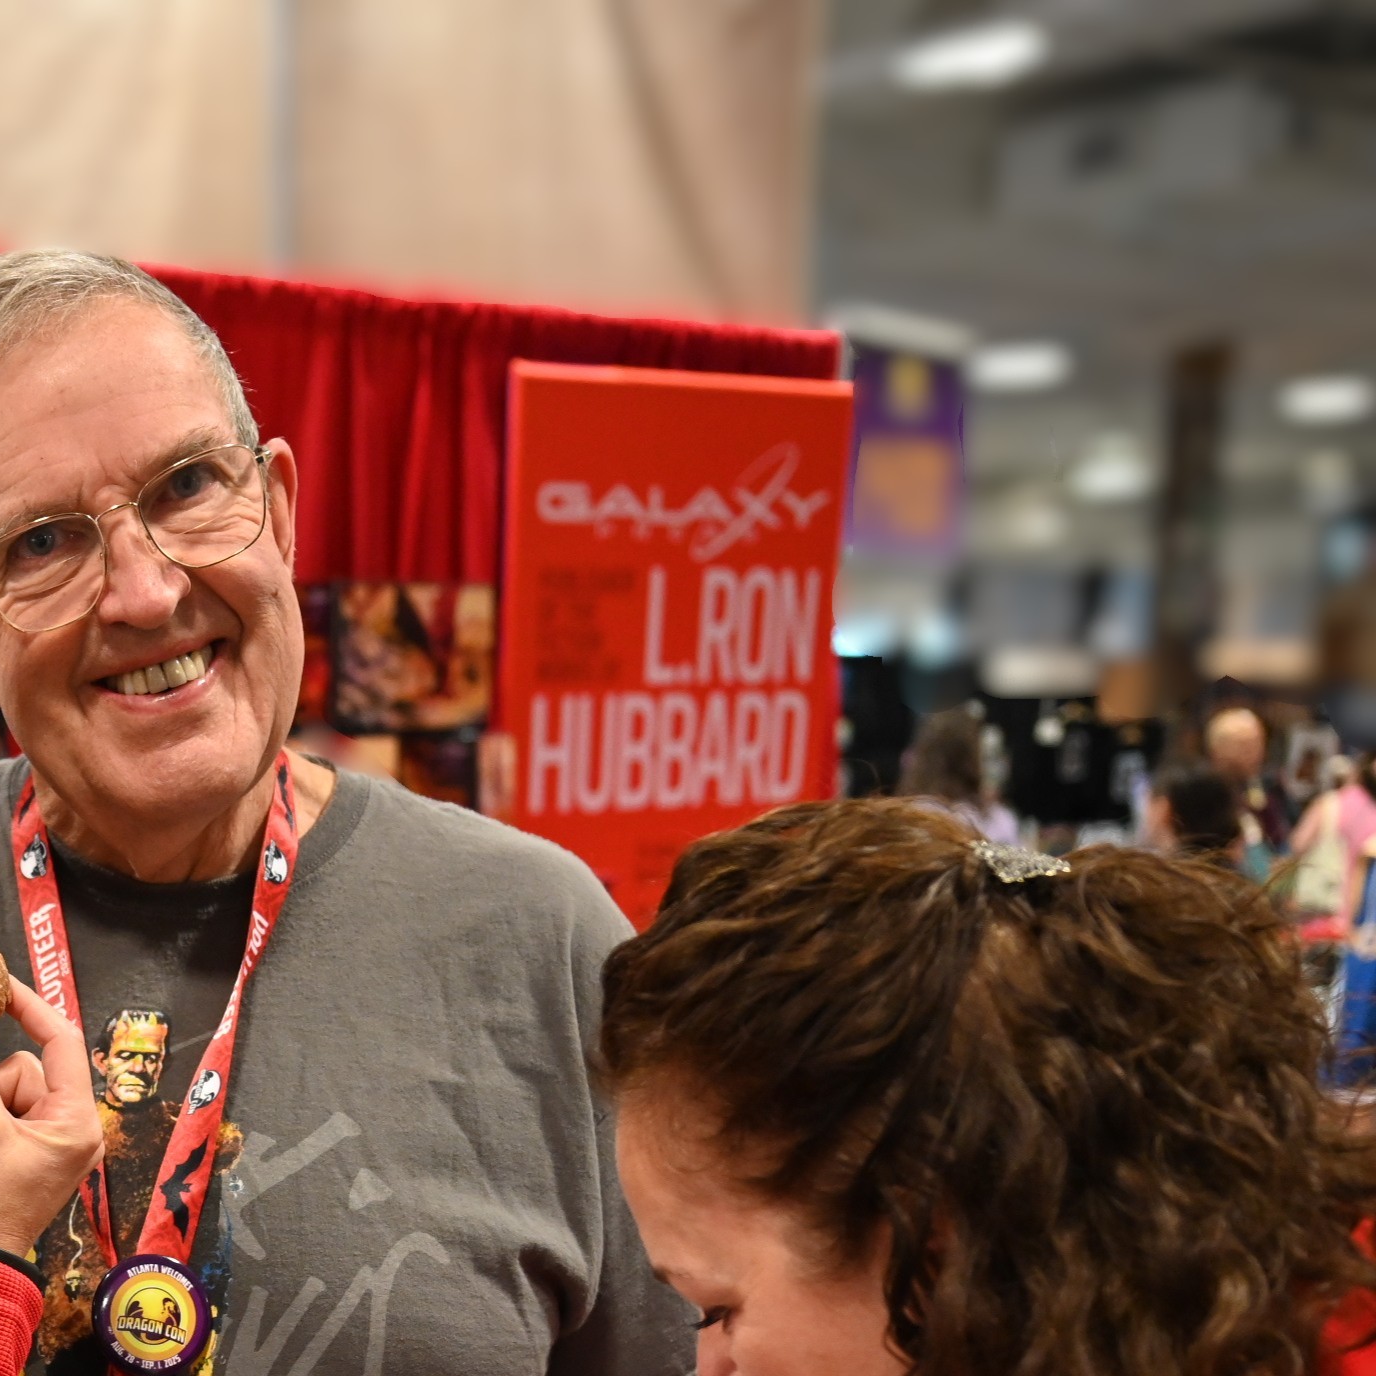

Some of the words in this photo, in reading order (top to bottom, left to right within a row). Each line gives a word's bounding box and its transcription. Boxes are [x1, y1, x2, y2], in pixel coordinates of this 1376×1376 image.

[536, 441, 830, 563] GALAXY
[528, 691, 810, 815] HUBBARD
[29, 903, 70, 1019] LUNTEER
[127, 1264, 158, 1278] ATLANTA
[161, 1265, 194, 1291] WELCOMES
[118, 1317, 163, 1334] DRAGON
[165, 1324, 186, 1343] CON
[164, 1355, 181, 1368] 2025
